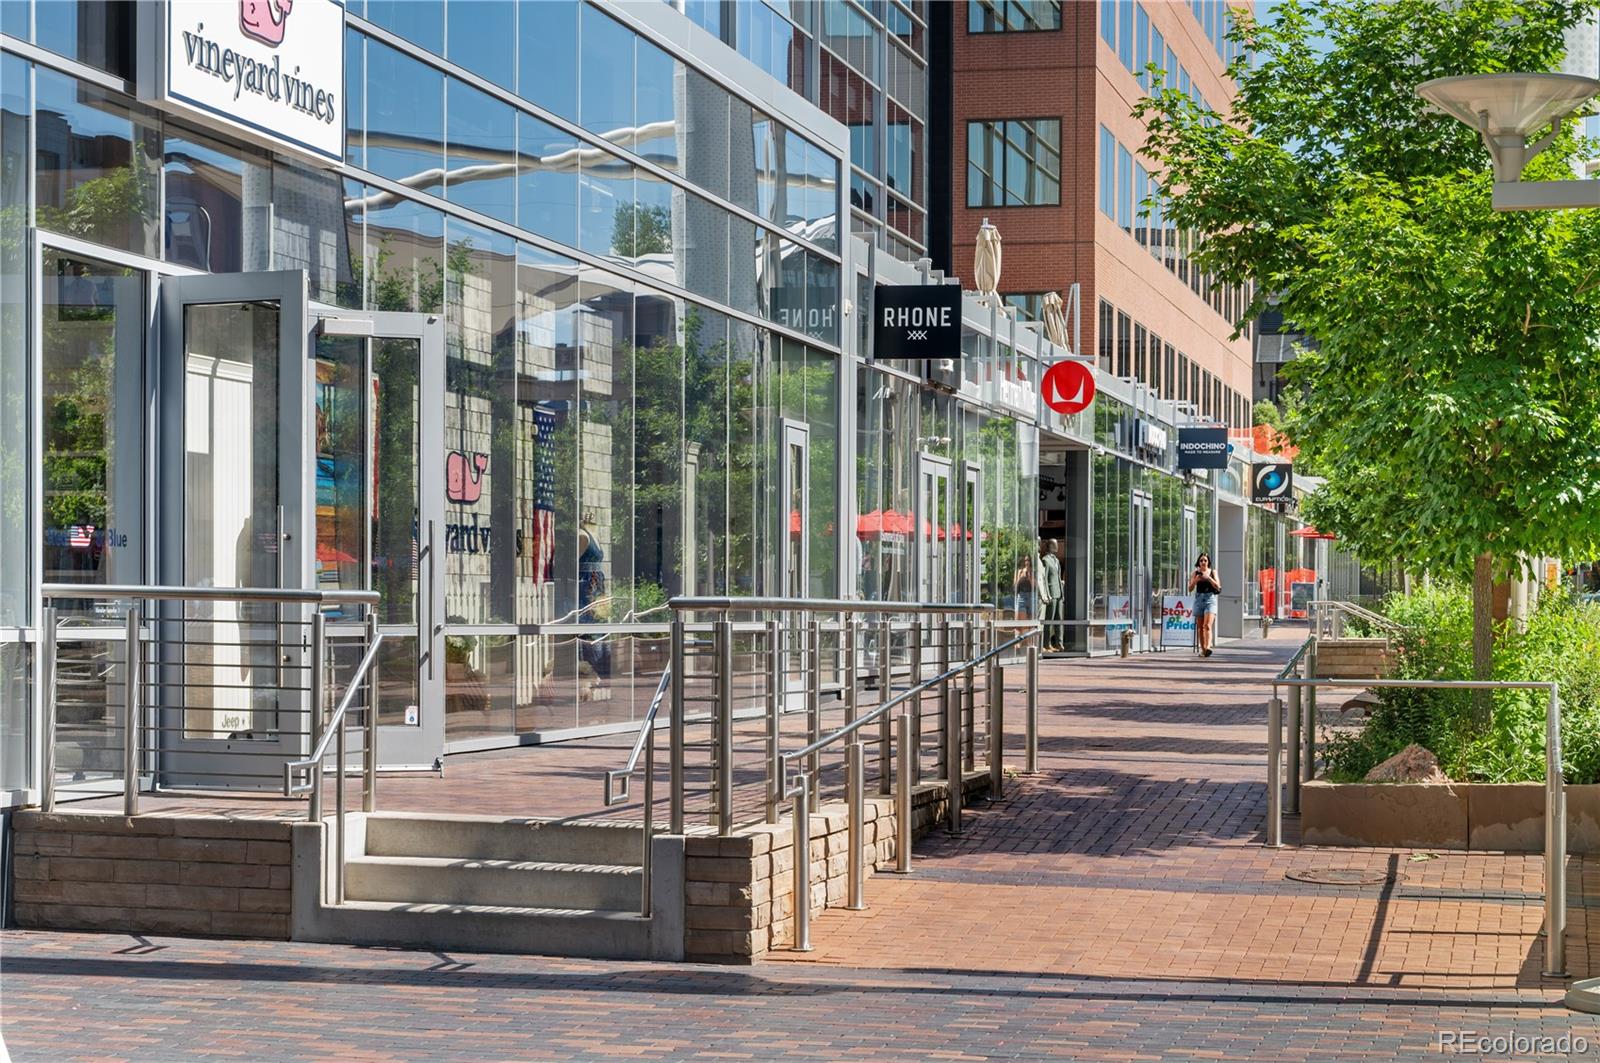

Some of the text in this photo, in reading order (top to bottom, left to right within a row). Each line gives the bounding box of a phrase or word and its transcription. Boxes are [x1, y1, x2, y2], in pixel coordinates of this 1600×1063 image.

[182, 22, 335, 124] vineyard vines
[883, 307, 952, 327] RHONE
[1180, 442, 1226, 450] INDOCHINO
[1175, 600, 1184, 609] A
[1162, 607, 1192, 618] Story
[1168, 615, 1181, 623] of
[221, 713, 240, 729] Jeep
